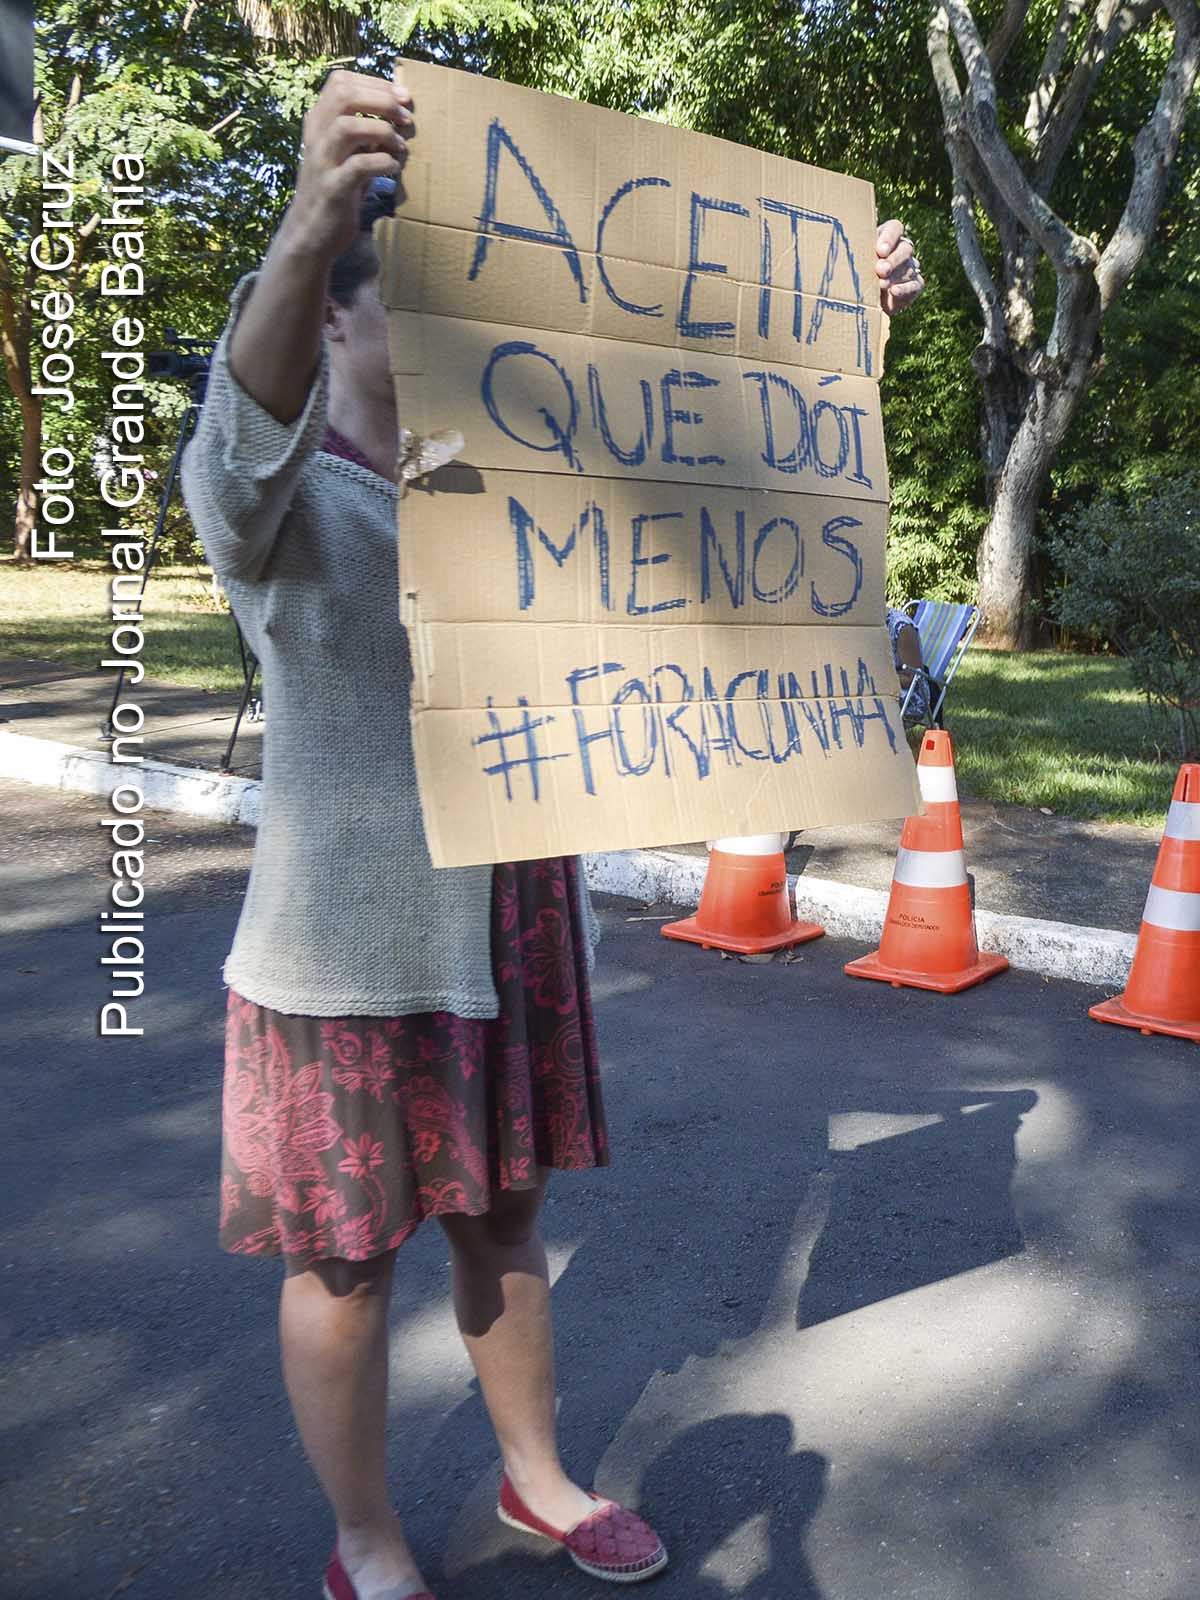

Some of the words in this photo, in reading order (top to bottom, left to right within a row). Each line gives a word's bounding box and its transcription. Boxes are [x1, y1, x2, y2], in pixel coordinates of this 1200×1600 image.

[467, 116, 872, 376] ACETA
[481, 341, 736, 473] QUE
[508, 496, 864, 617] MENOS
